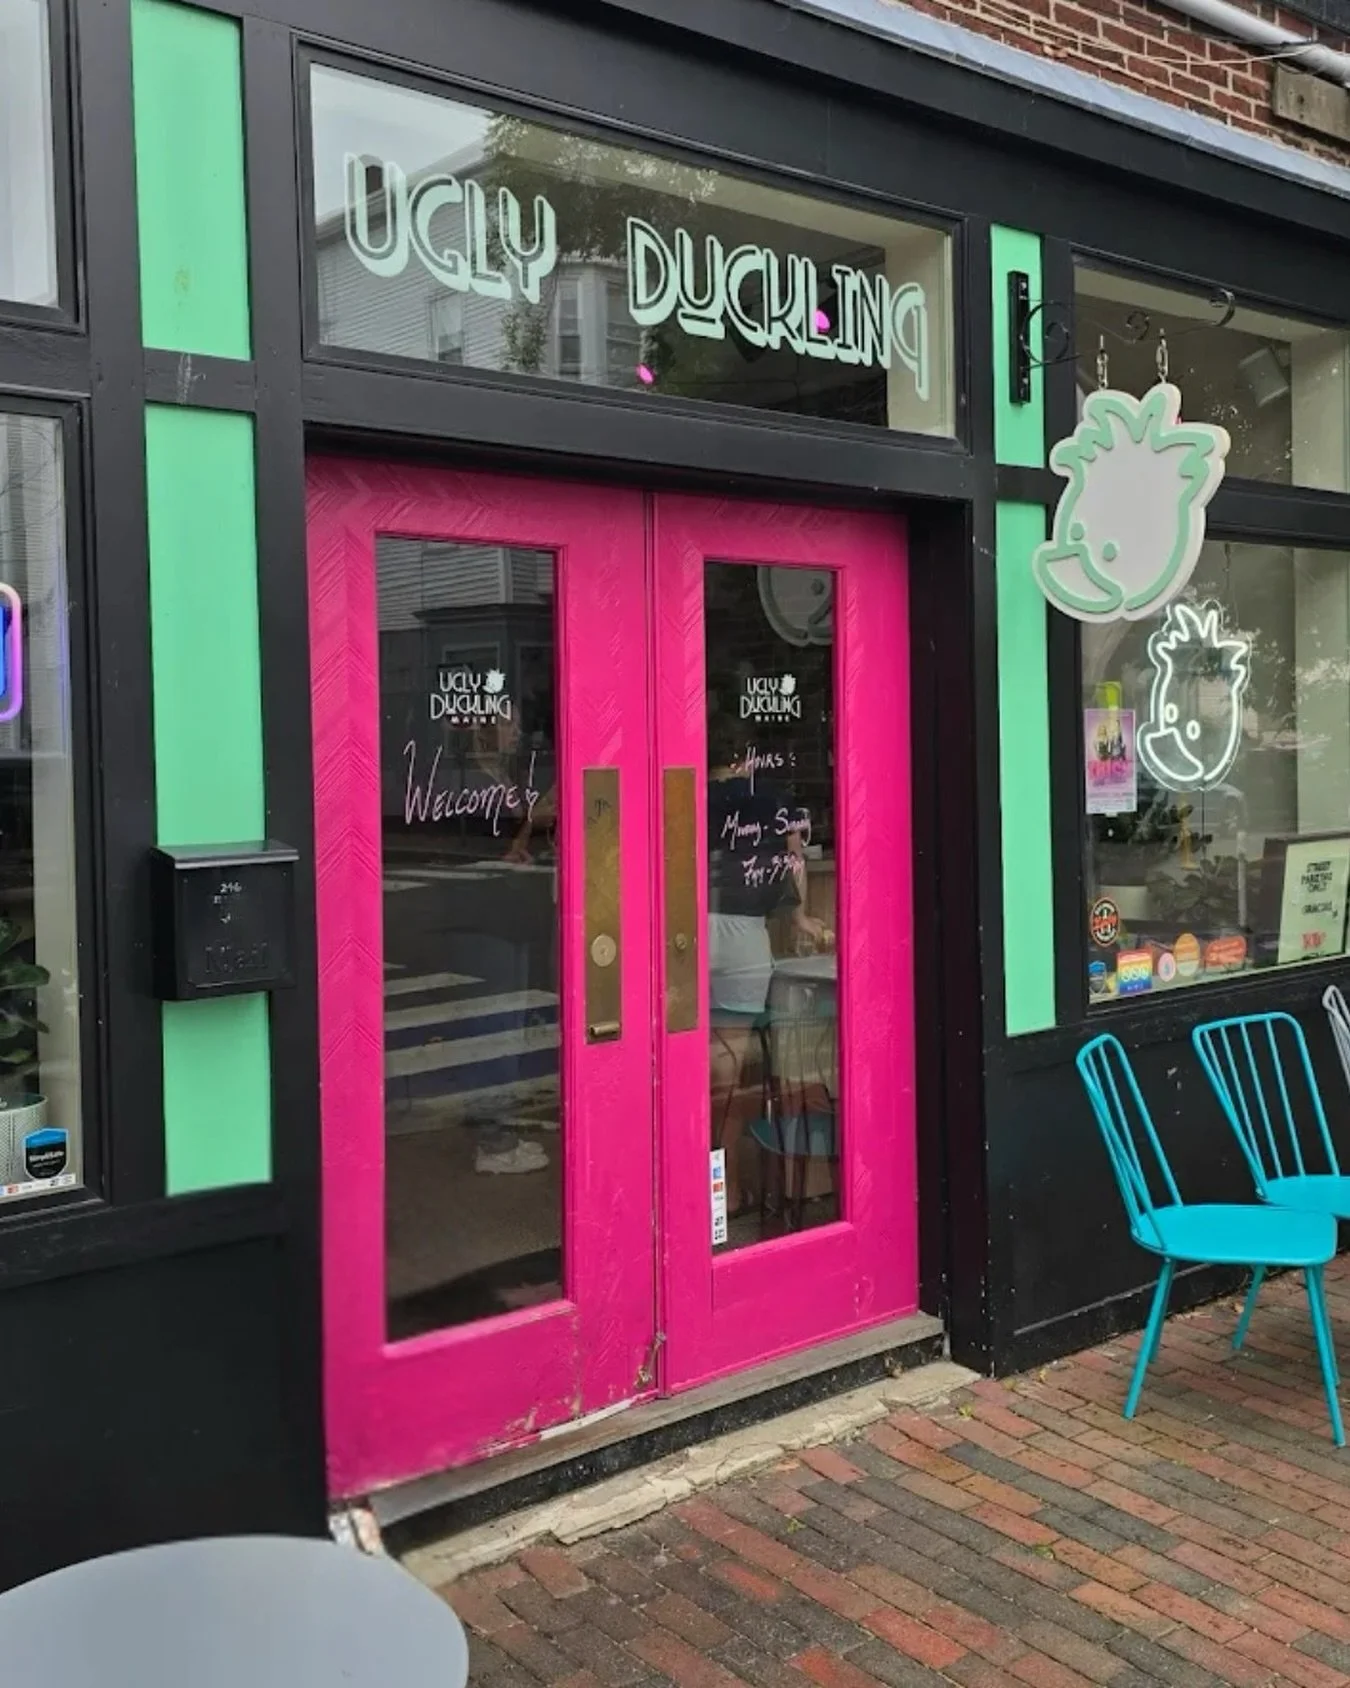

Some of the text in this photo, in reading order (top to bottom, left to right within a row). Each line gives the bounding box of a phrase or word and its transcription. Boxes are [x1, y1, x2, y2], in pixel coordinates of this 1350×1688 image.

[344, 152, 929, 401] UGLY DUCKLING
[439, 671, 481, 693] UGLY
[747, 677, 779, 695] UGLY
[430, 693, 512, 721] DUCKLING
[740, 695, 801, 719] DUCKLING
